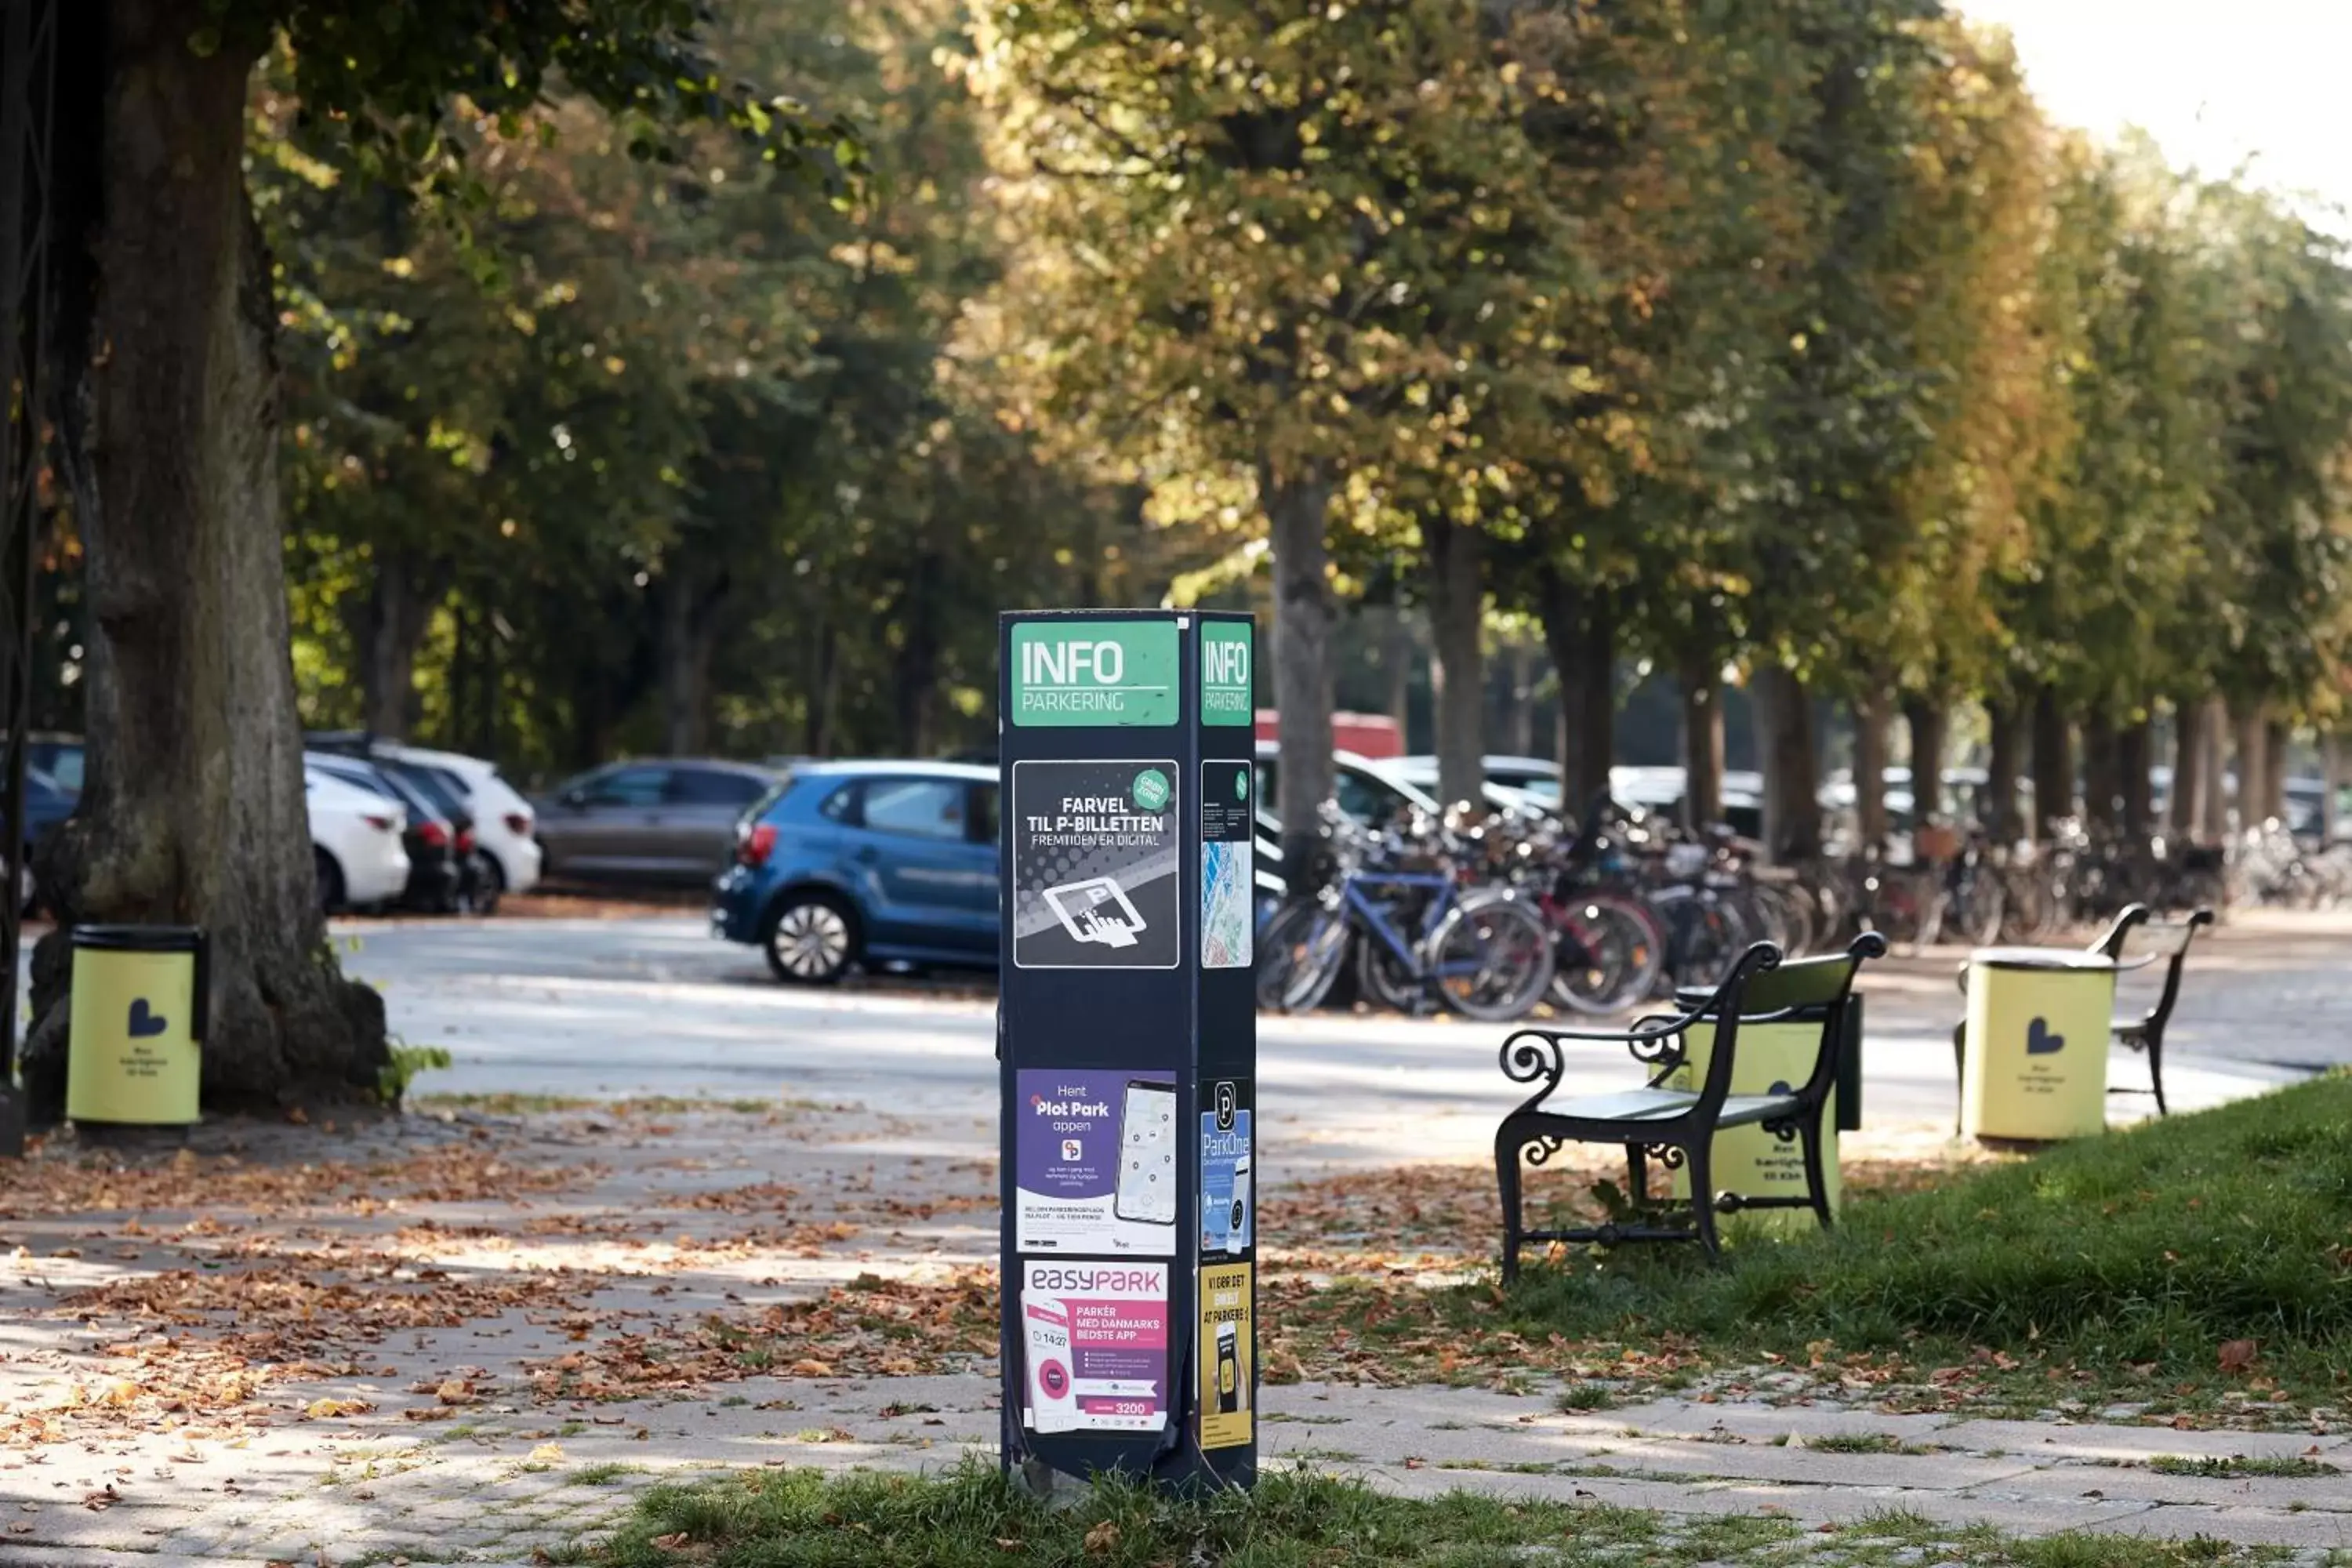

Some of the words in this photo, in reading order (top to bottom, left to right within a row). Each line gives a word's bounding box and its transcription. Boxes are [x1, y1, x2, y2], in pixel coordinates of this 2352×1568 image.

[1022, 641, 1123, 684] INFO
[1205, 641, 1247, 684] INFO
[1022, 692, 1124, 711] PARKERING
[1205, 693, 1248, 711] PARKERING
[1062, 797, 1128, 813] FARVEL
[1027, 816, 1053, 833] TIL
[1057, 816, 1163, 833] P-BILLETTEN
[1032, 834, 1096, 847] FREMTIDEN
[1099, 835, 1115, 847] ER
[1118, 835, 1160, 847] DIGITAL
[1058, 1085, 1087, 1097] Hent
[1036, 1102, 1069, 1116] Plot
[1072, 1102, 1110, 1118] Park
[1053, 1121, 1091, 1134] appen
[1203, 1132, 1250, 1157] ParkOne
[1076, 1305, 1116, 1316] PARKÉR
[1076, 1319, 1098, 1328] MED
[1101, 1319, 1160, 1330] DANMARKS
[1116, 1330, 1137, 1341] APP
[1116, 1403, 1145, 1414] 3200
